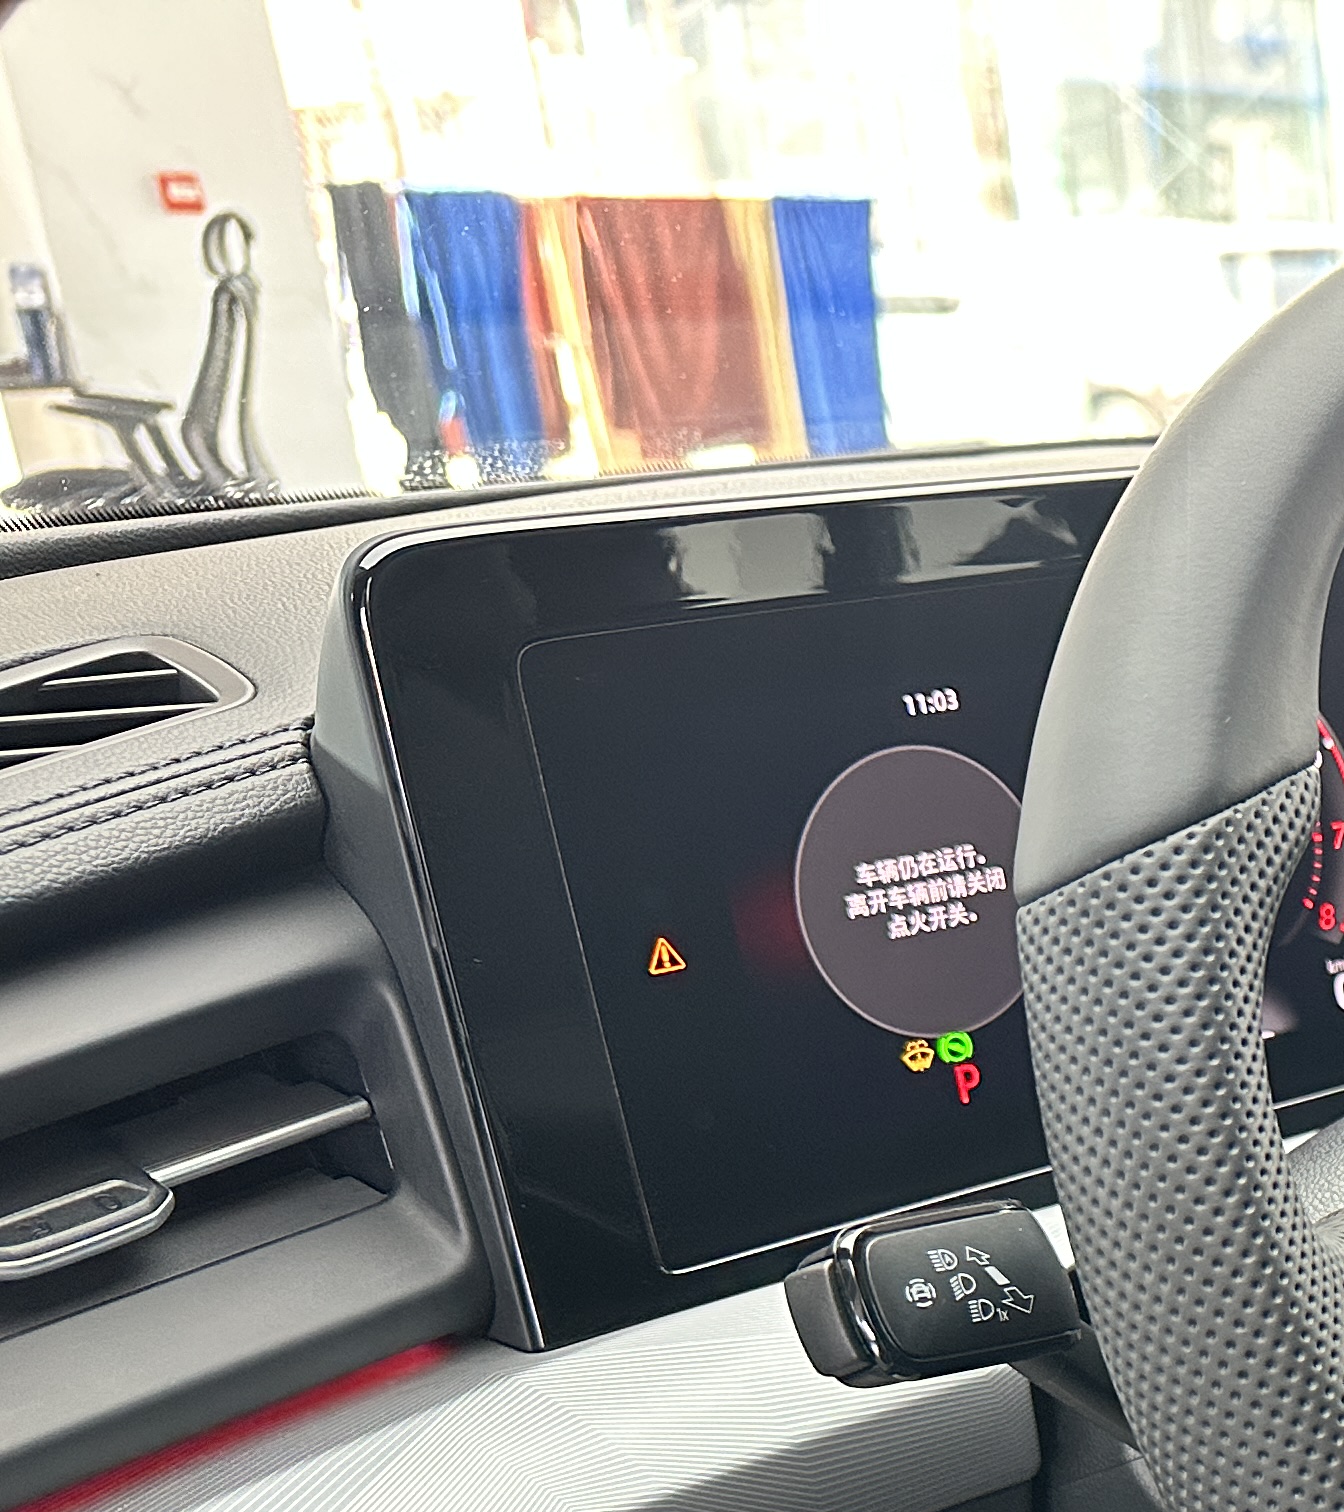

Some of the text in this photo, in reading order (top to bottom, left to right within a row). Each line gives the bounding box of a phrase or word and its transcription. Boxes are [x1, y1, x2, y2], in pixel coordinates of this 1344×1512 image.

[902, 687, 960, 717] 11:03
[844, 866, 1007, 919] 离开车辆前请关闭
[1318, 902, 1336, 931] 8
[954, 1062, 981, 1105] P
